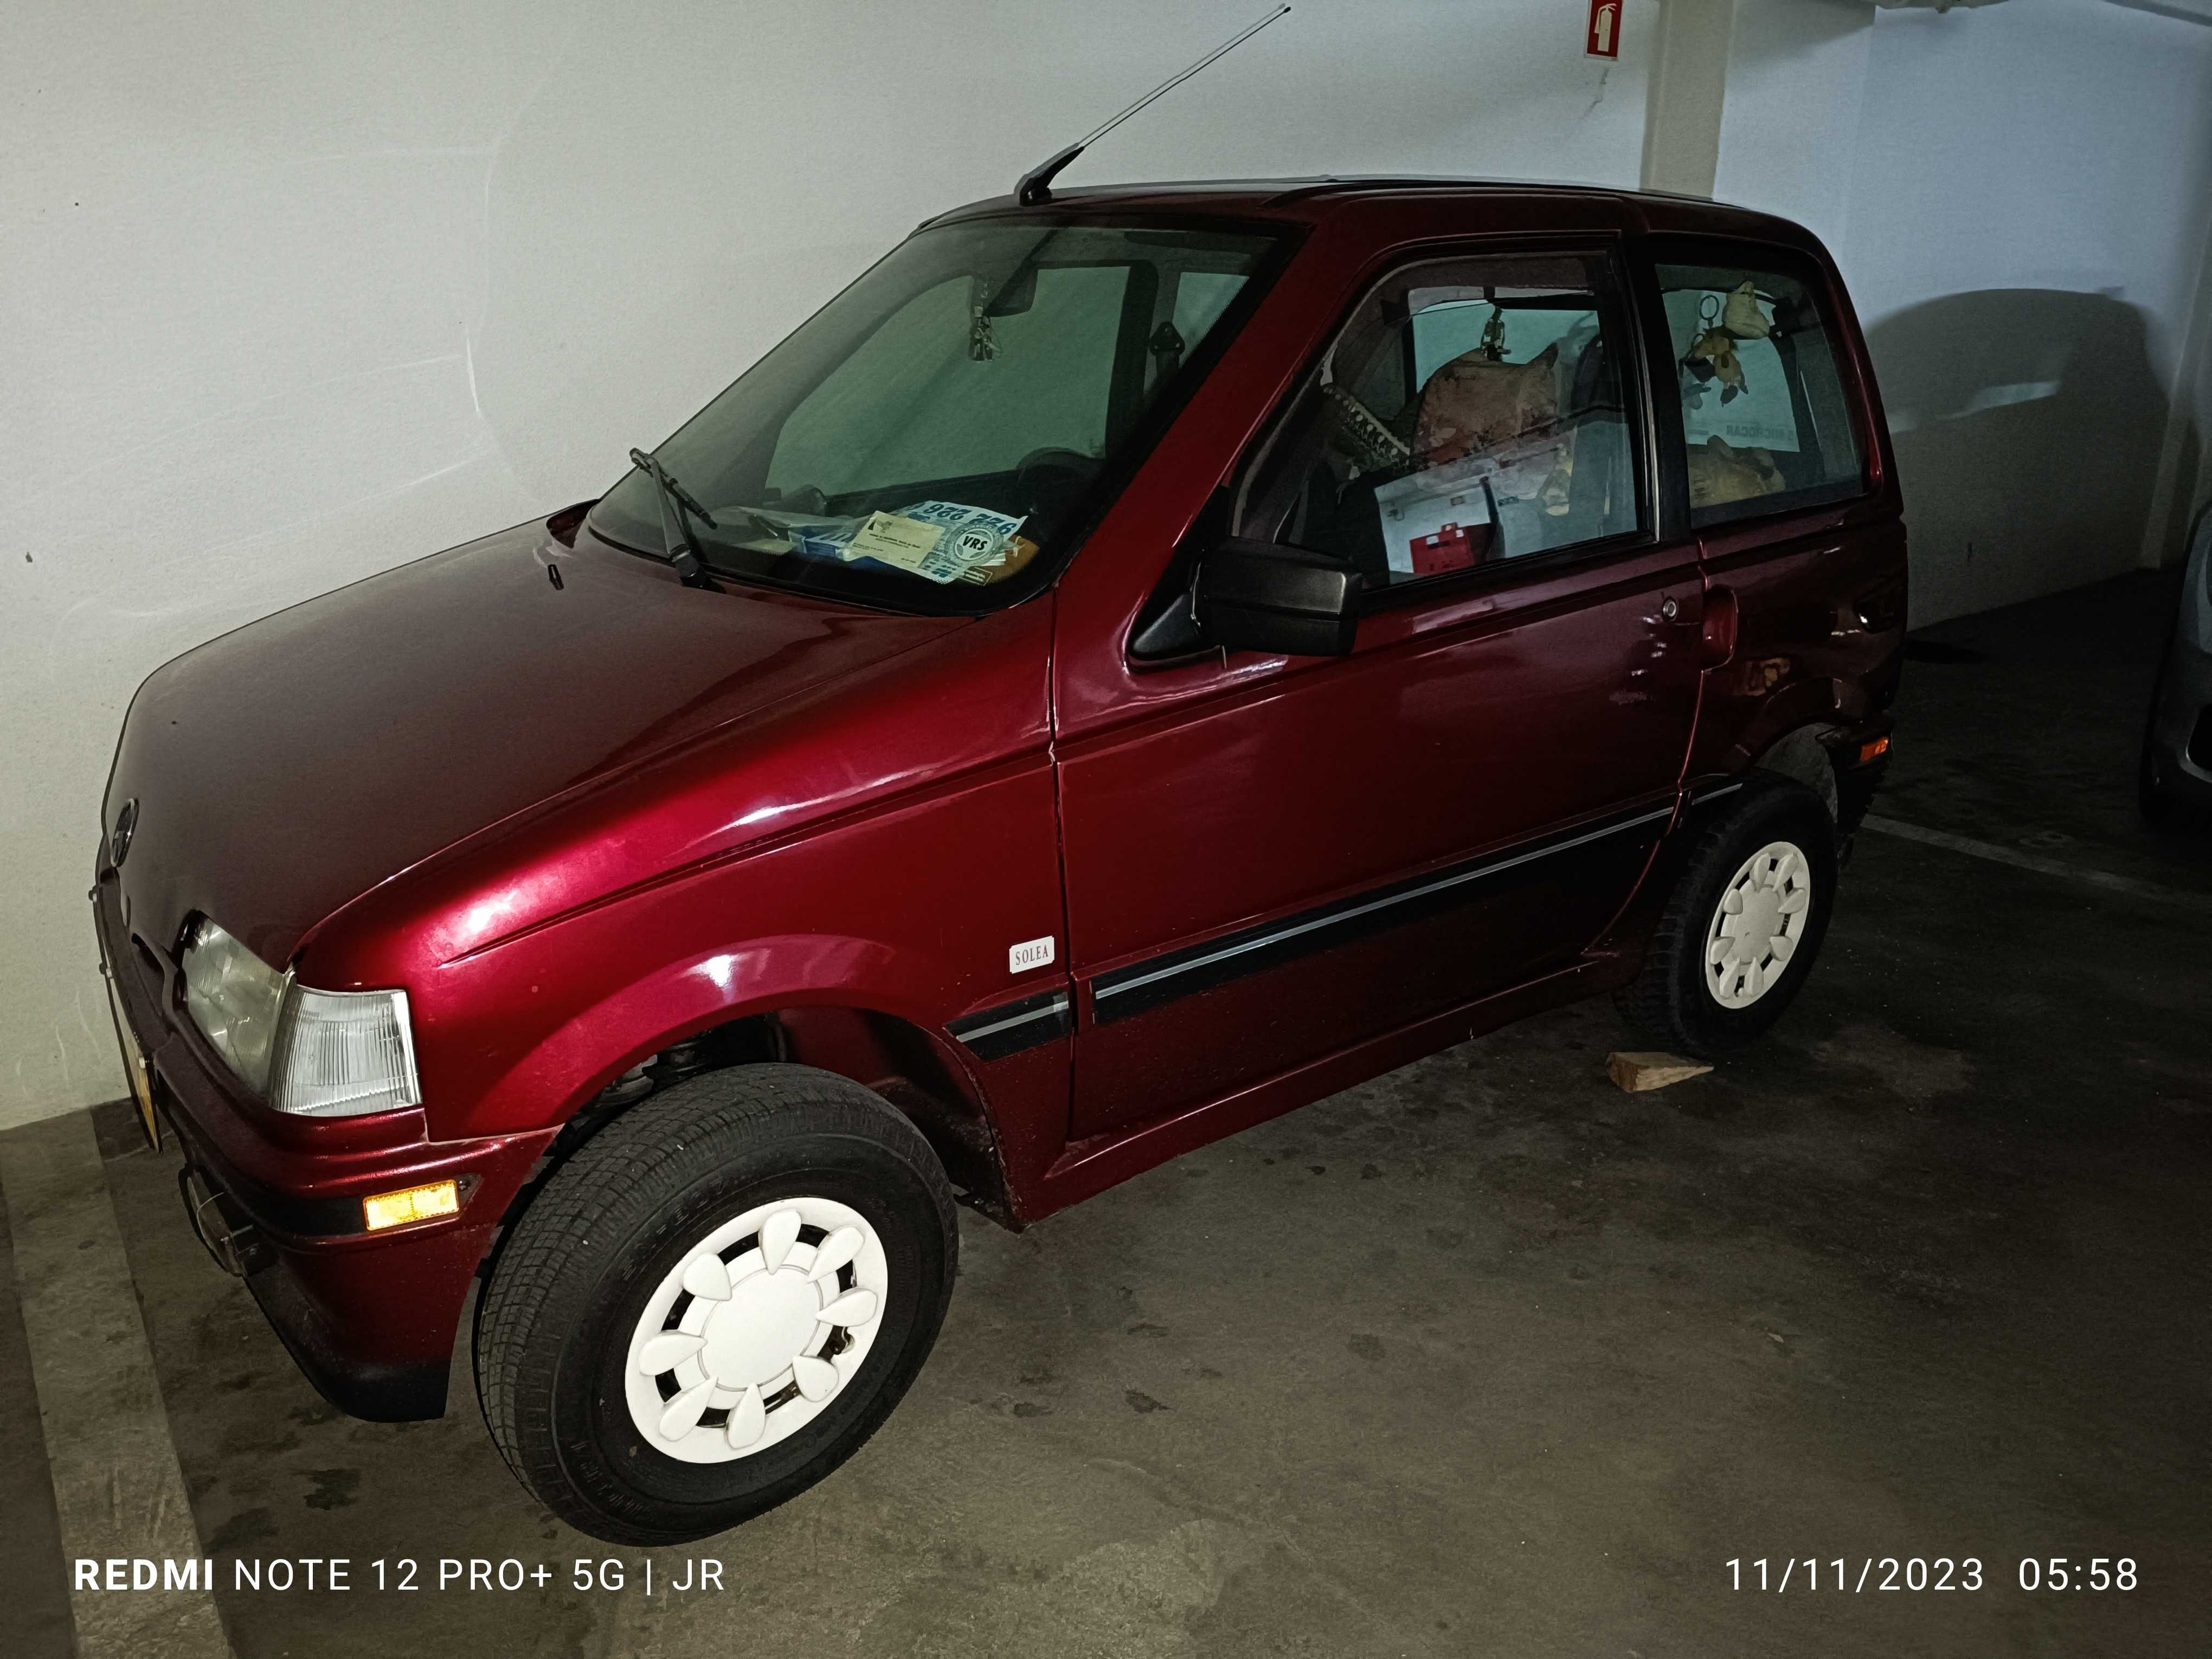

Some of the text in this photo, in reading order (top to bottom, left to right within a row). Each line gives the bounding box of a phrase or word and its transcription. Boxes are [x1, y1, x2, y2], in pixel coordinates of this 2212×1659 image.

[923, 504, 972, 520] 226
[962, 535, 988, 551] VRS
[1015, 944, 1049, 966] SOLEA
